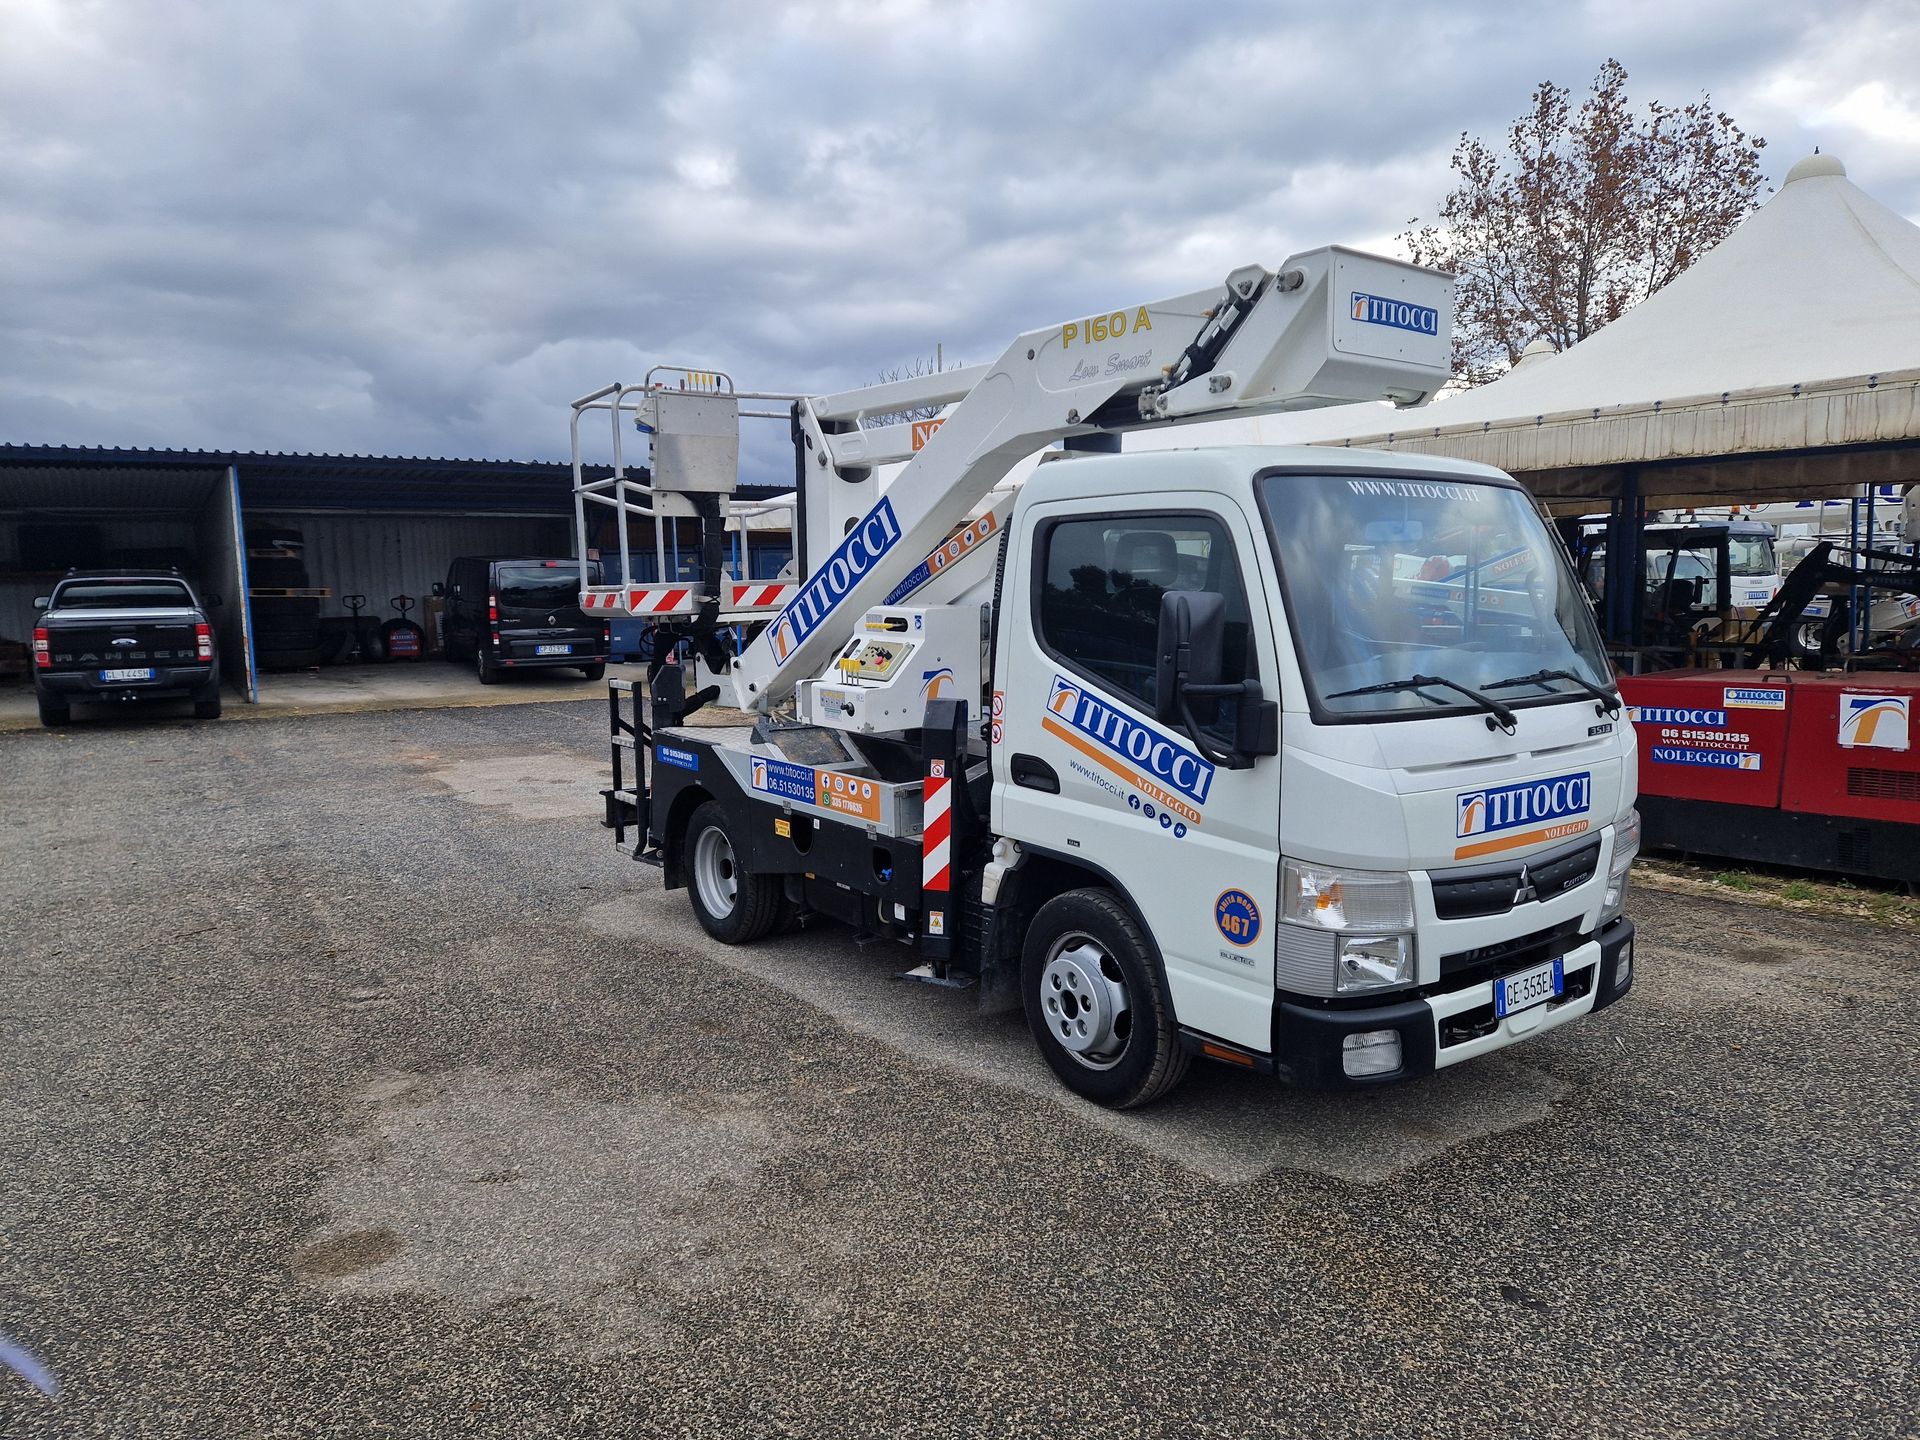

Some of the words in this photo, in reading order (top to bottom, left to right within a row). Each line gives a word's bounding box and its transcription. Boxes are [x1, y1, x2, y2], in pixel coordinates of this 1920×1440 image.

[1369, 298, 1437, 332] TITOCCI
[1062, 322, 1078, 350] P
[1085, 312, 1127, 345] 160
[1132, 305, 1153, 334] A
[1068, 359, 1099, 382] Low
[1105, 348, 1153, 376] Smart
[1347, 481, 1481, 503] WWW.TITOCCI.IT
[789, 503, 898, 637] TITOCCI
[883, 565, 930, 606] www.titocci.it
[55, 649, 195, 662] RANGER
[1737, 690, 1783, 700] TITOCCI
[1642, 707, 1726, 726] TITOCCI
[1661, 728, 1679, 738] 06
[1681, 730, 1750, 743] 51530135
[1661, 738, 1750, 751] WWW.TITOCCI.IT
[1079, 696, 1212, 800] TITOCCI
[1653, 748, 1739, 766] NOLEGGIO
[767, 763, 814, 782] www.titocci.it
[1069, 759, 1125, 800] www.titocci.it
[768, 779, 815, 800] 06.51530135
[1135, 776, 1198, 822] NOLEGGIO
[1488, 776, 1590, 826] TITOCCI
[1543, 821, 1587, 840] NOLEGGIO
[1221, 913, 1250, 937] 467
[1219, 951, 1256, 967] BLUETEC
